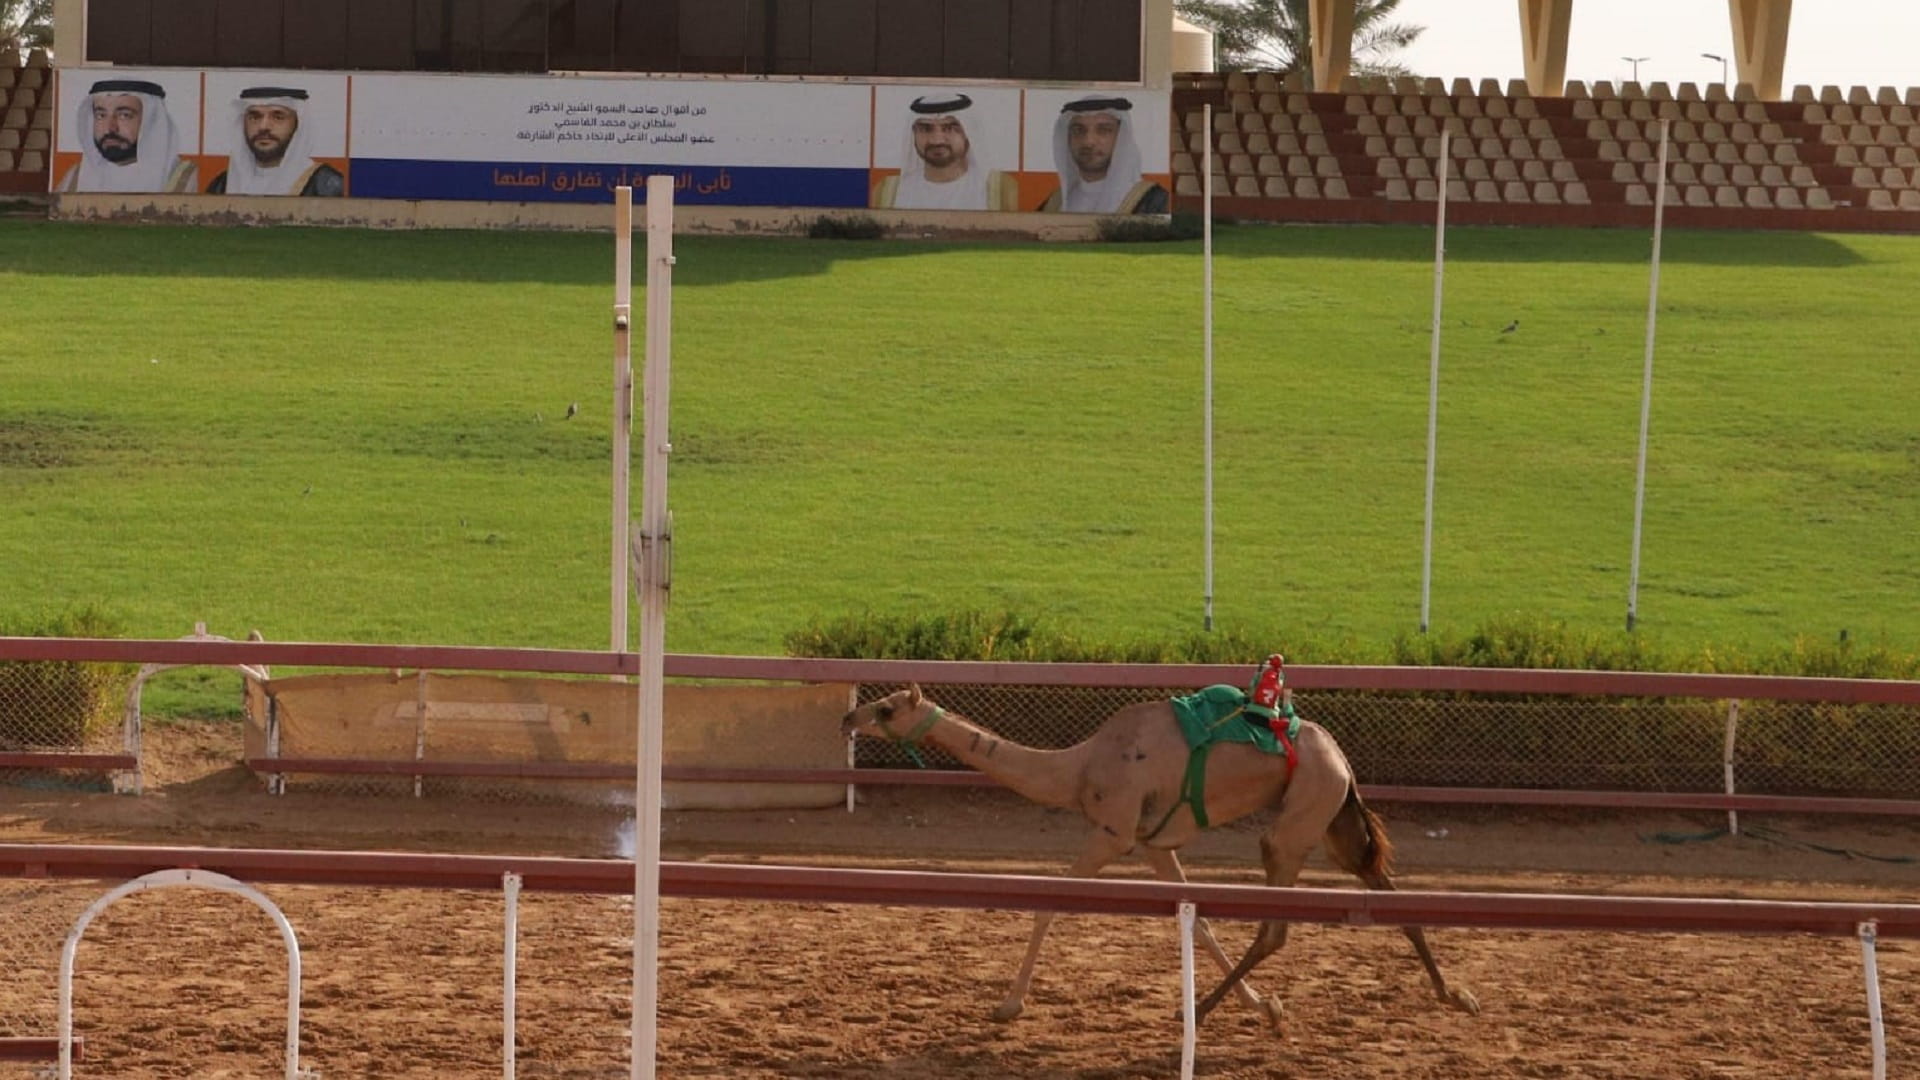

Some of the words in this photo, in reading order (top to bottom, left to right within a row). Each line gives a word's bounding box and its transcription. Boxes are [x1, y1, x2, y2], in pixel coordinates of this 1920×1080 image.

[528, 101, 564, 114] الدكتور
[566, 101, 593, 115] الشيخ
[595, 103, 625, 115] السمو
[627, 103, 659, 115] صاحب
[691, 105, 707, 116] من
[554, 117, 597, 129] القاسمي
[600, 118, 626, 127] محمد
[628, 119, 641, 130] بن
[642, 118, 677, 130] سلطان
[516, 129, 555, 142] الشارقة
[557, 130, 582, 143] حاكم
[650, 132, 687, 144] المجلس
[690, 132, 716, 144] عضو
